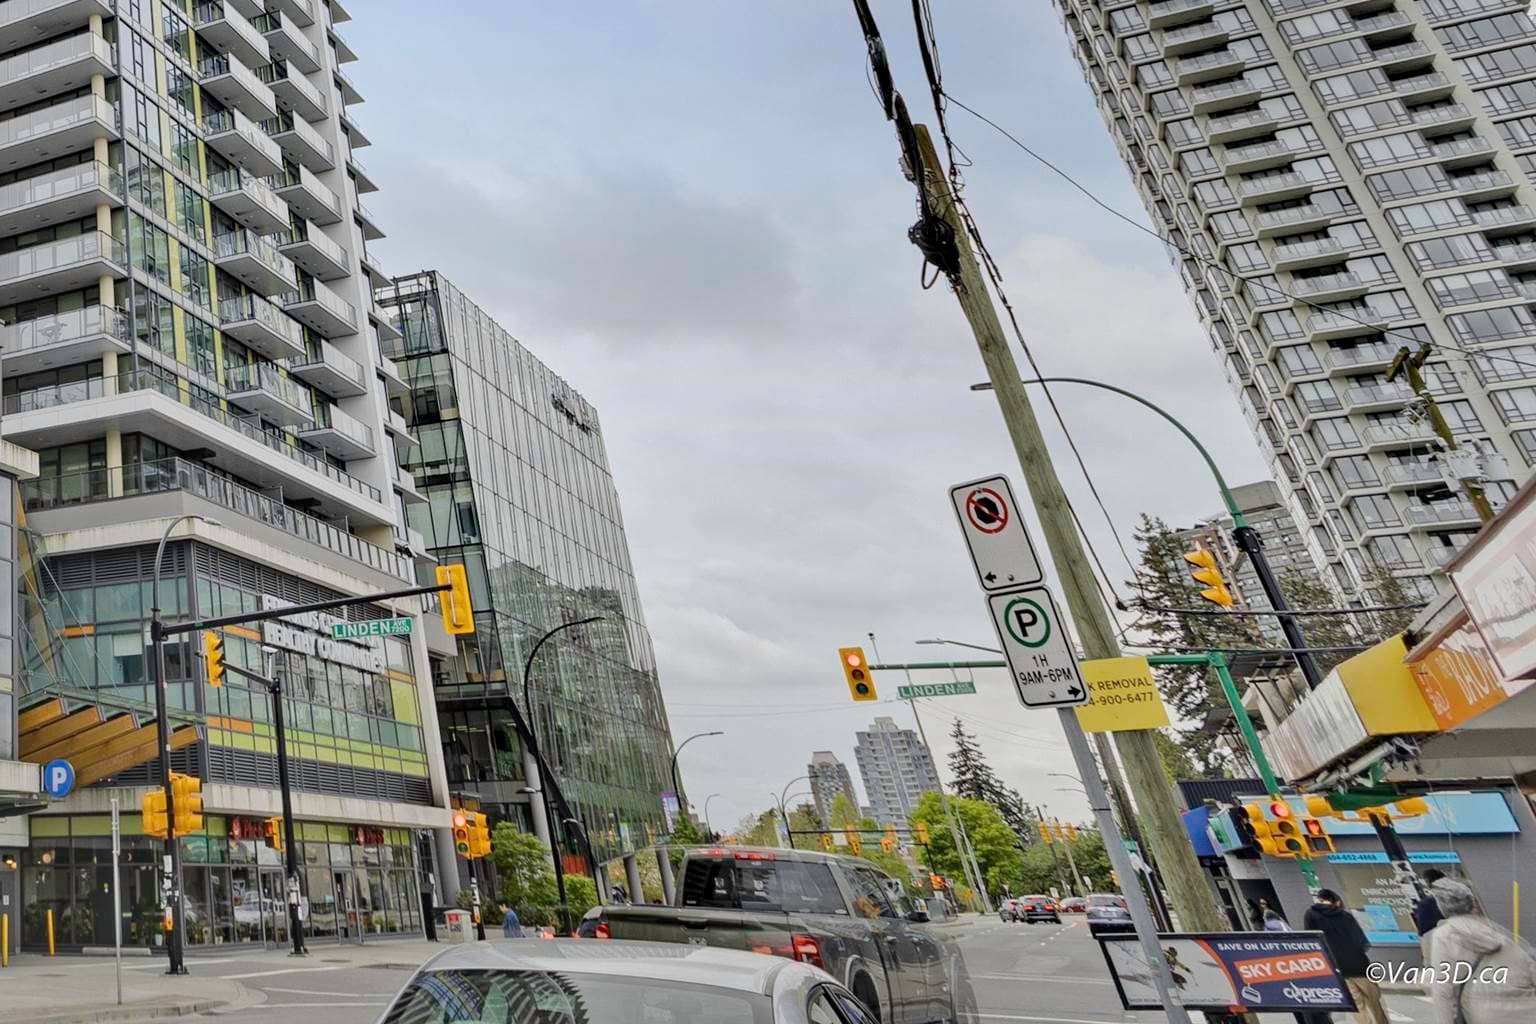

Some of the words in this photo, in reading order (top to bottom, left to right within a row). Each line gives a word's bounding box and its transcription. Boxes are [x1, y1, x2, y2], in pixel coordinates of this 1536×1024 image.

[334, 621, 391, 638] LINDEN
[1014, 608, 1038, 637] P
[1032, 654, 1049, 667] 1H
[1018, 667, 1075, 686] 9AM-6PM
[1098, 677, 1152, 691] REMOVAL
[901, 684, 956, 697] LINDEN
[1076, 692, 1154, 707] 4-900-6477
[52, 767, 67, 792] P
[1217, 942, 1242, 951] SAVE
[1244, 942, 1258, 951] ON
[1260, 942, 1280, 951] LIFT
[1282, 942, 1322, 951] TICKETS
[1239, 963, 1273, 979] SKY
[1275, 957, 1325, 974] CARD
